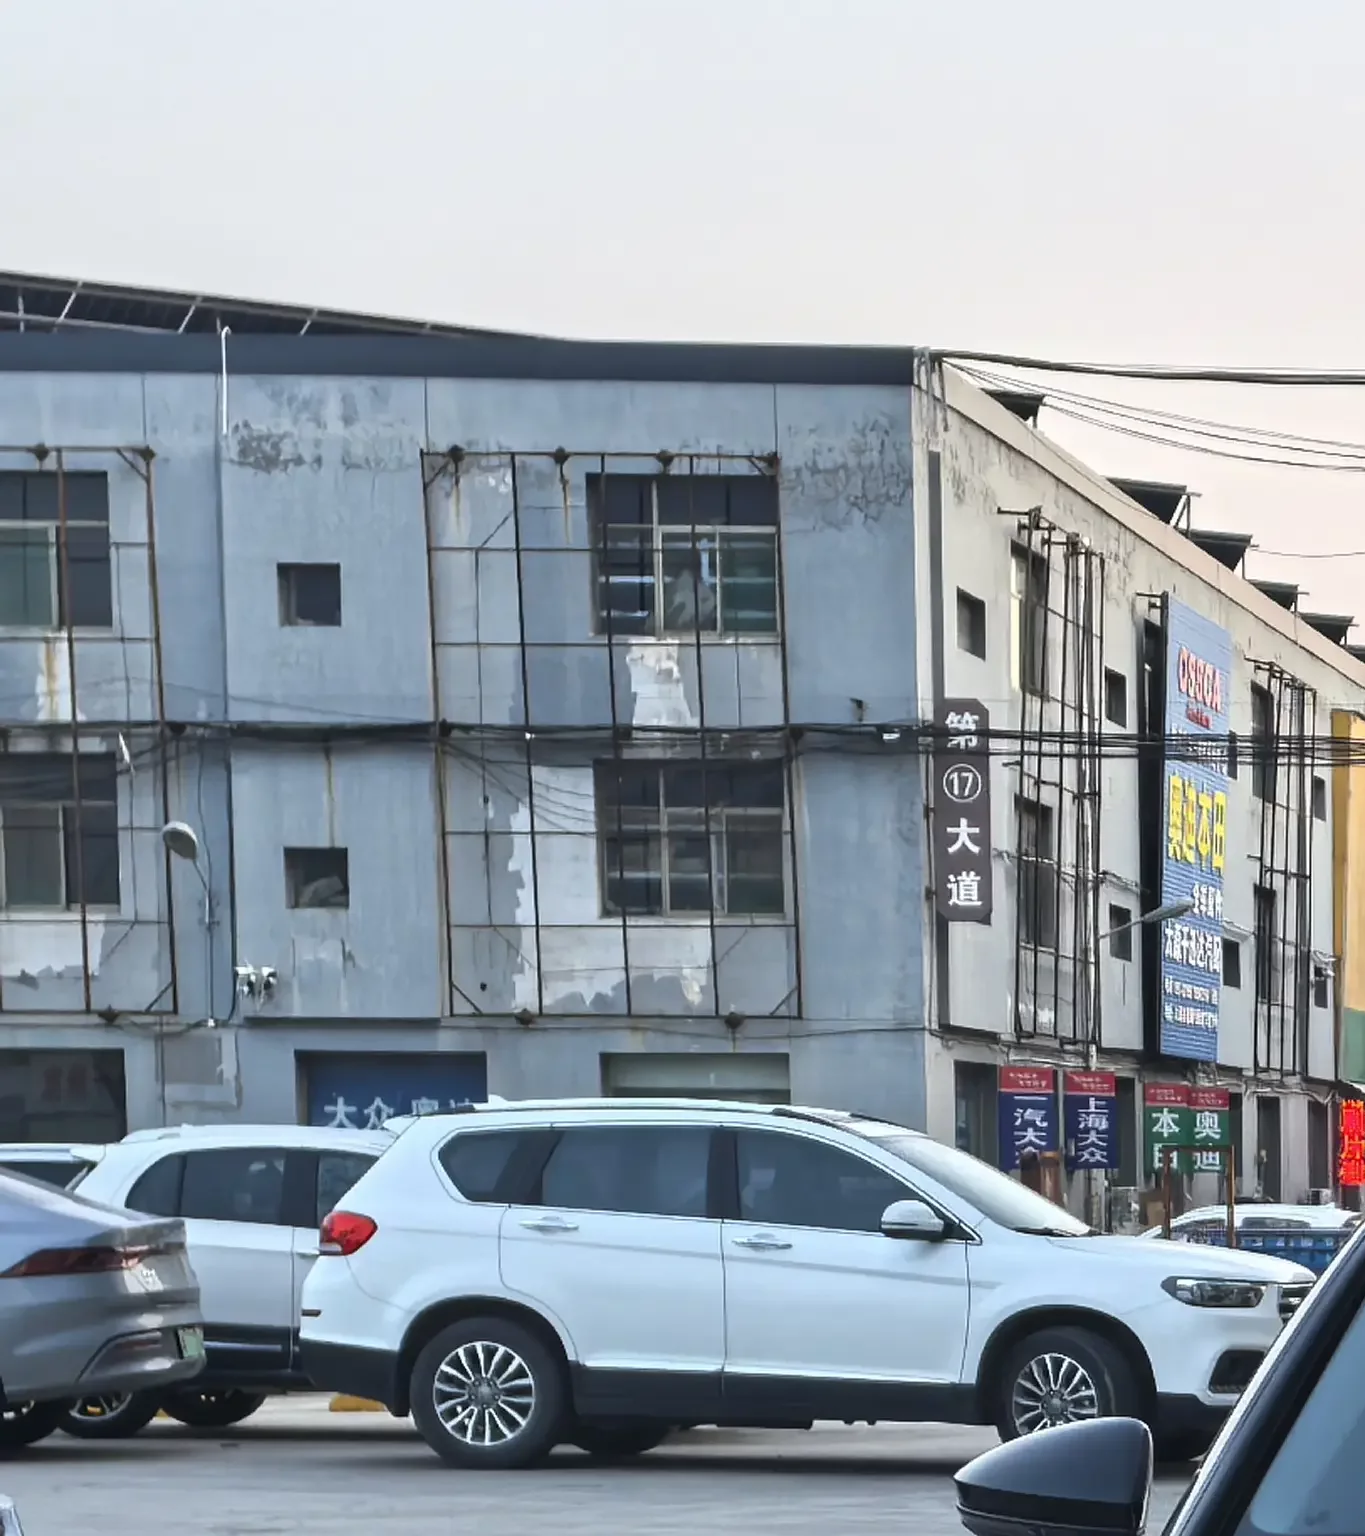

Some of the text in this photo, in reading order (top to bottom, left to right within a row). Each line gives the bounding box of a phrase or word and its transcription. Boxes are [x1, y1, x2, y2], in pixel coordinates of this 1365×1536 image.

[1168, 770, 1227, 877] 奥迪本田
[1077, 1097, 1109, 1163] 上海大众
[1193, 1111, 1222, 1170] 奥迪
